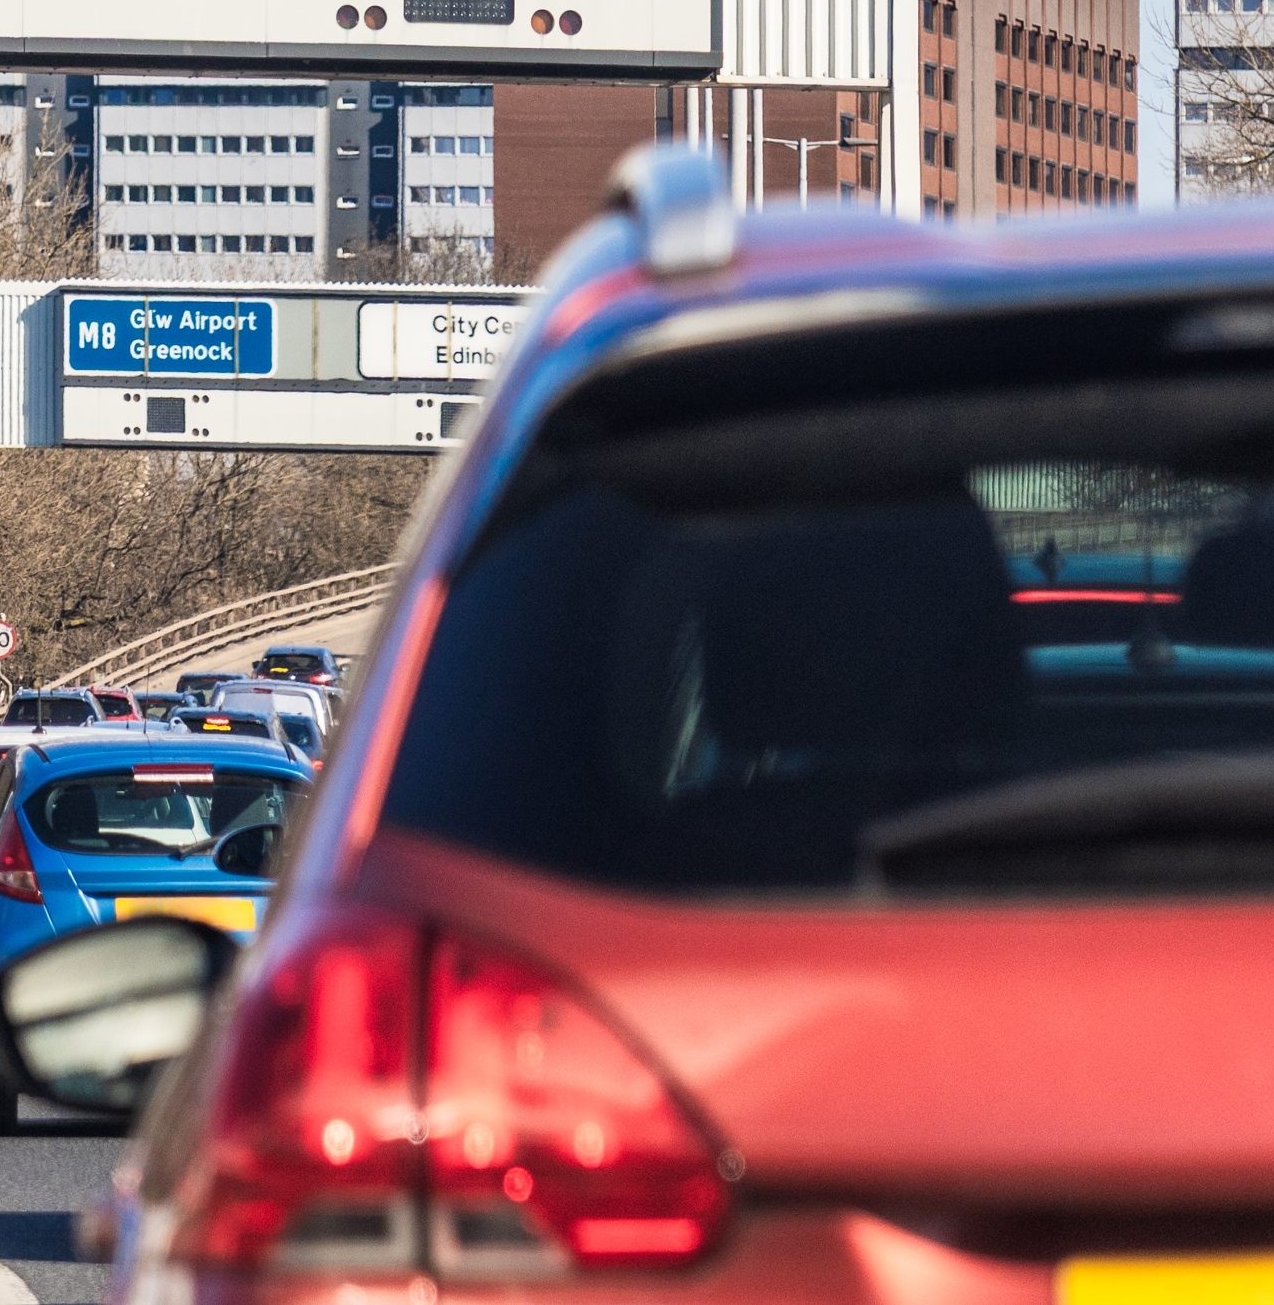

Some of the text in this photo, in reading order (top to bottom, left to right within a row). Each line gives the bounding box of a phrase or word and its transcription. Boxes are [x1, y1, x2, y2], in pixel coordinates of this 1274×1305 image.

[179, 310, 257, 334] Airport
[433, 315, 478, 337] City
[79, 321, 116, 350] M8
[130, 339, 234, 361] Greenock
[436, 345, 503, 365] Edinb
